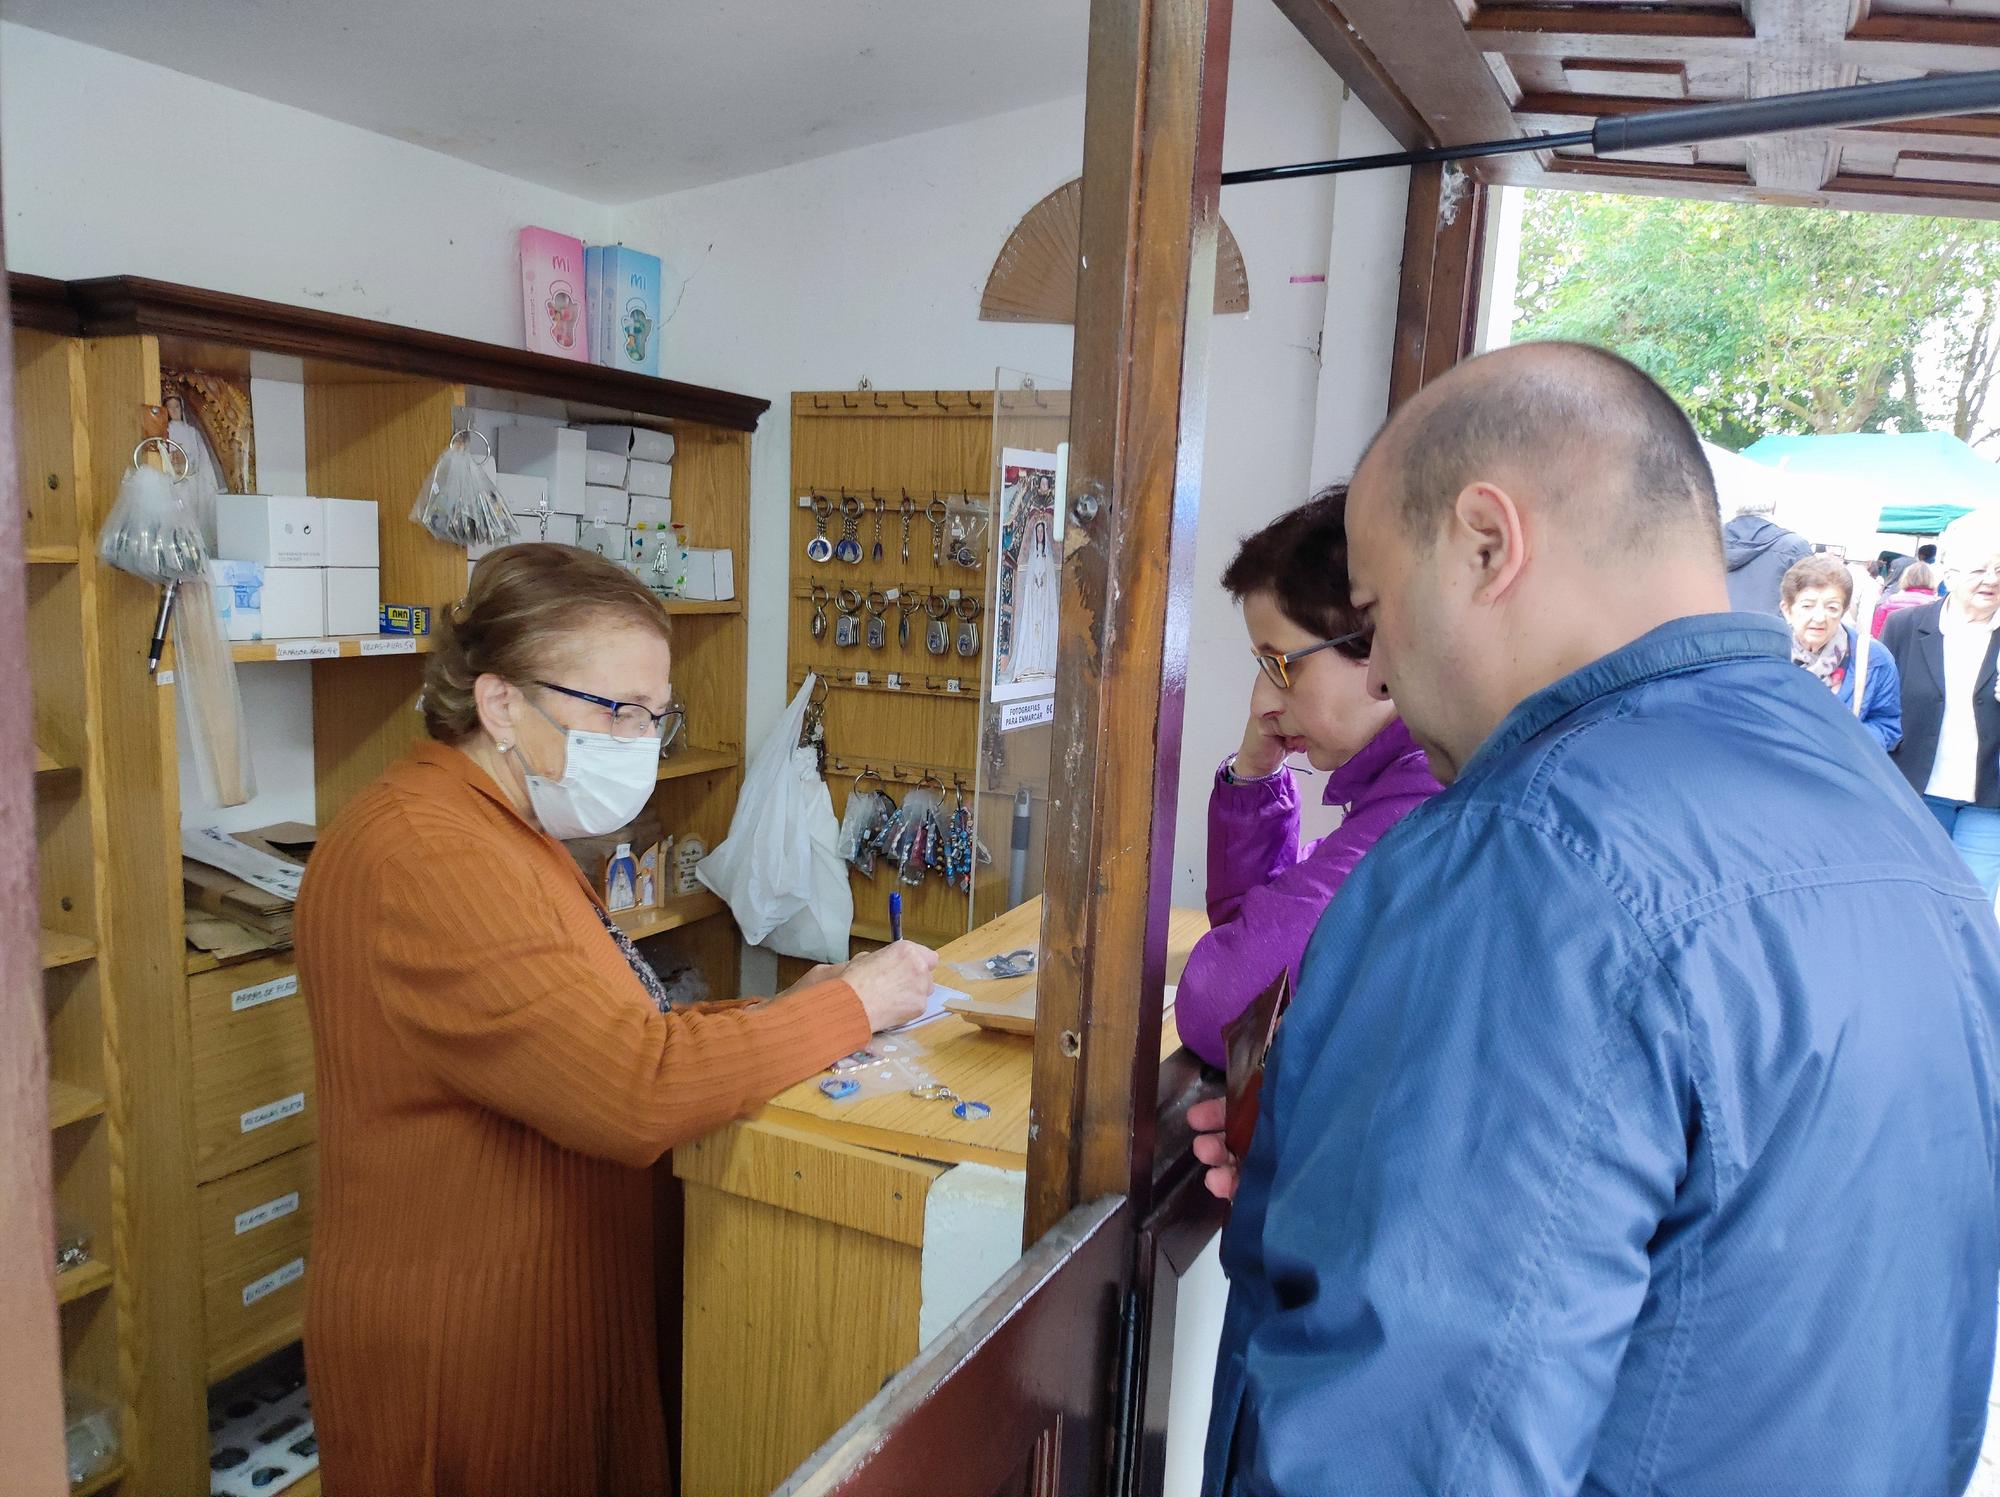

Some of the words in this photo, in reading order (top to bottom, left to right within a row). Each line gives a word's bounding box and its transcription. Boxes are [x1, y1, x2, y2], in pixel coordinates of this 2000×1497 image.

[392, 610, 408, 619] UHU
[1005, 717, 1018, 726] PARA
[1019, 712, 1042, 723] ENMARCAR
